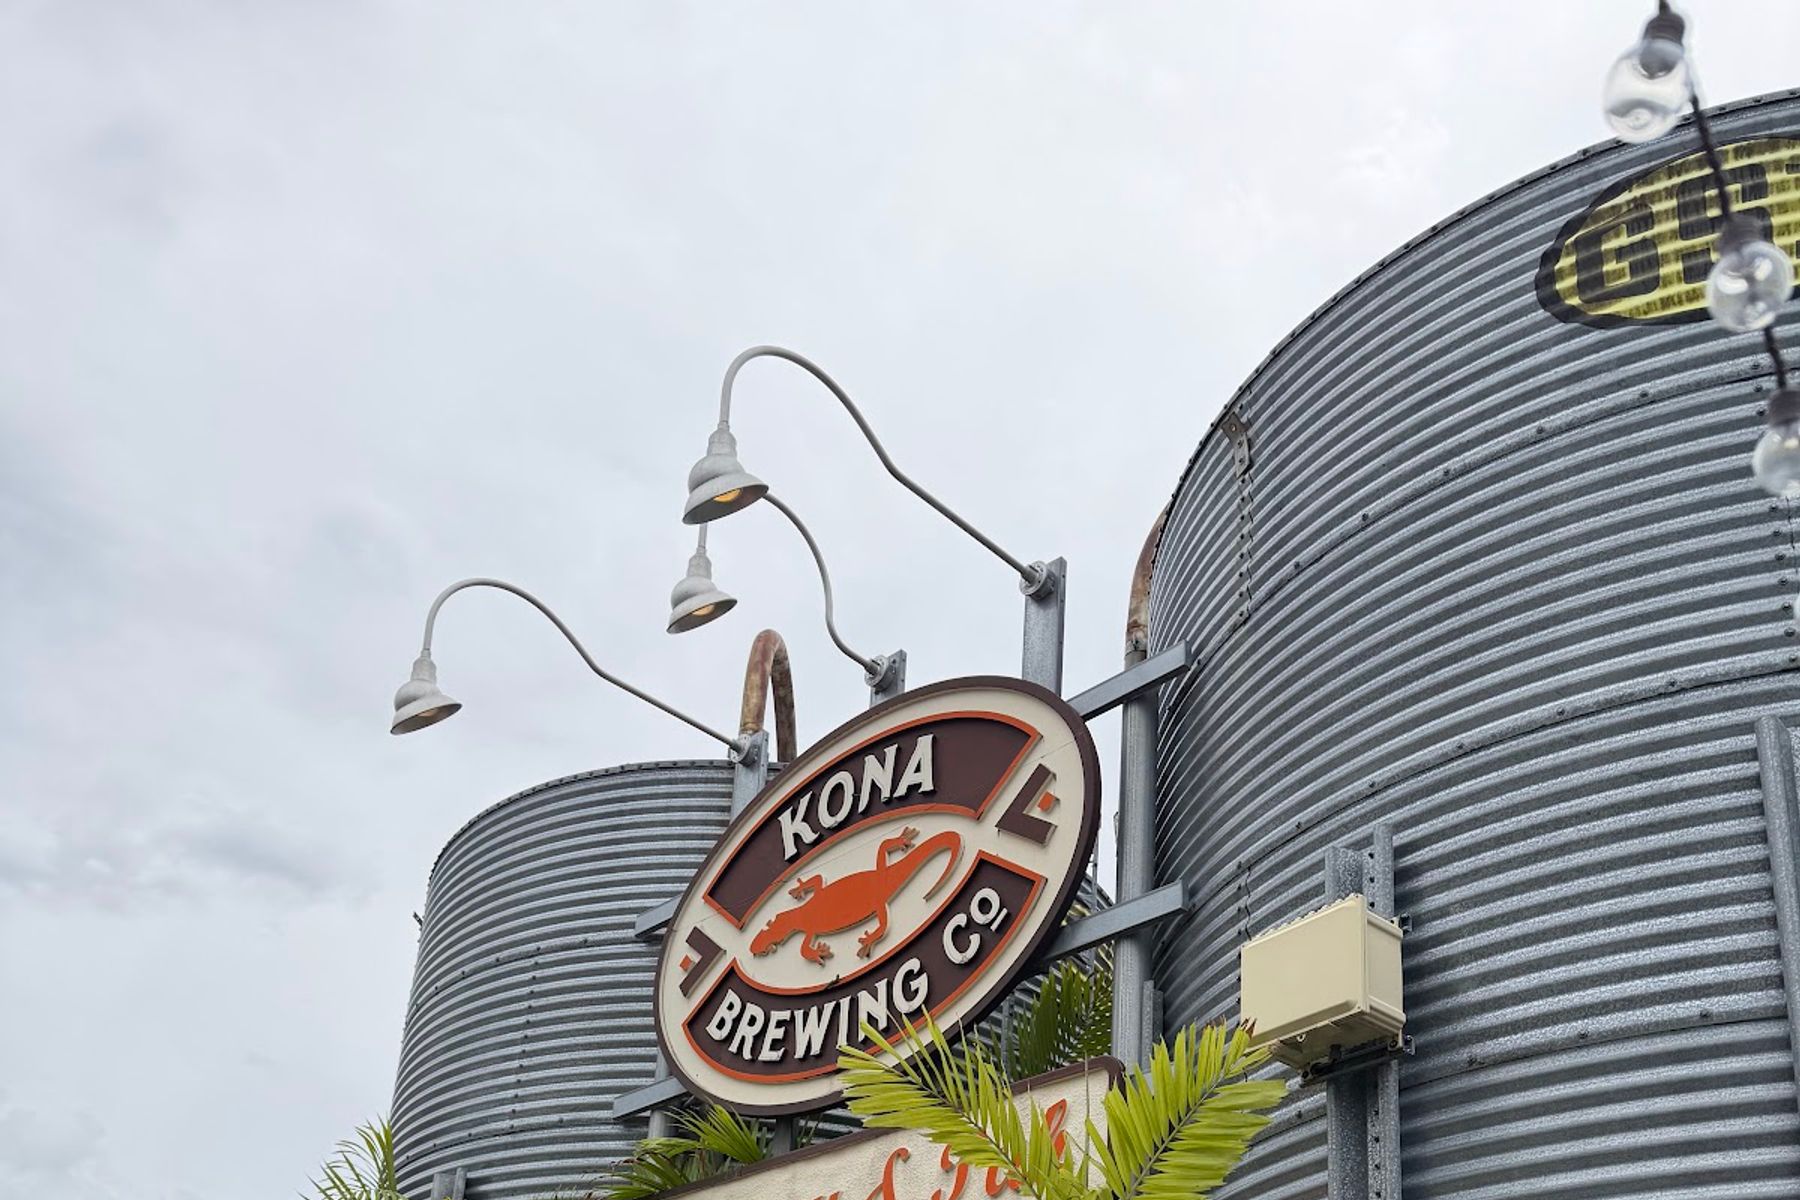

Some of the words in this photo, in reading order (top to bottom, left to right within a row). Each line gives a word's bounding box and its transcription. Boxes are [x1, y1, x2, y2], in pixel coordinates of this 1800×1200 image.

[1573, 162, 1800, 304] GS
[777, 733, 936, 862] KONA
[704, 957, 930, 1063] BREWING
